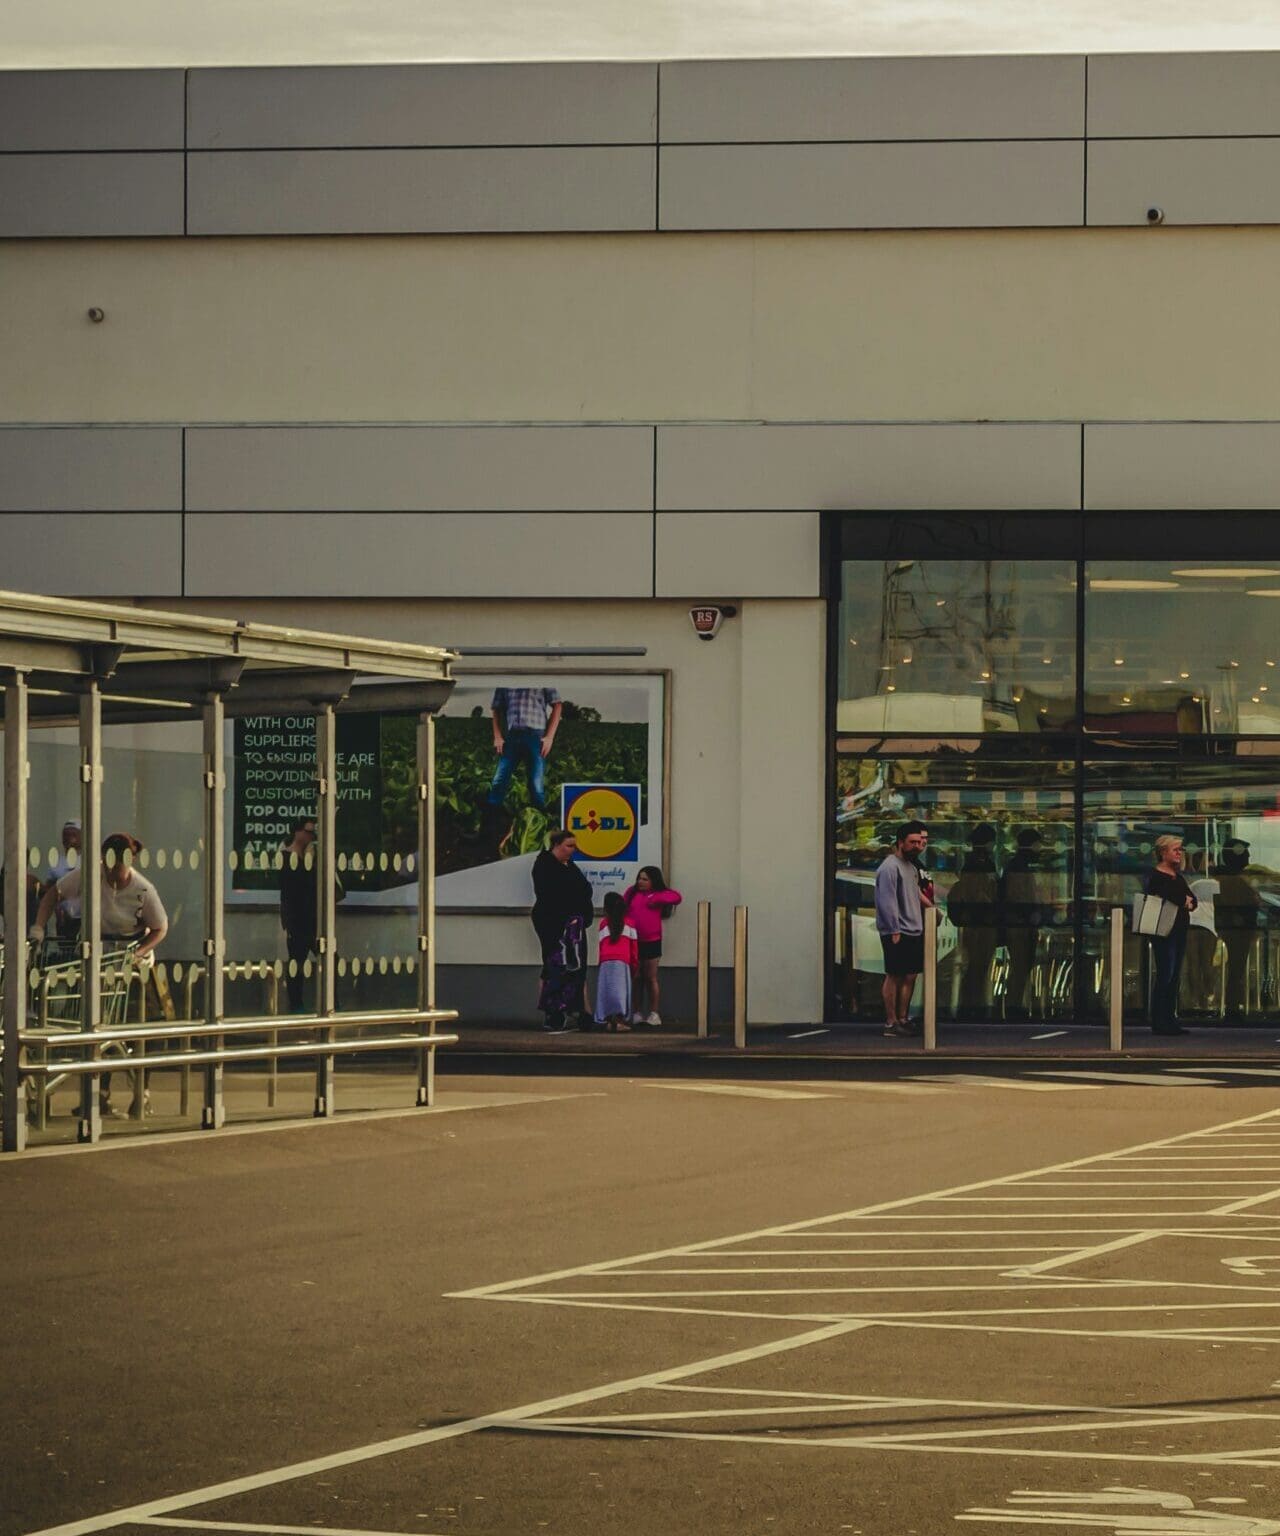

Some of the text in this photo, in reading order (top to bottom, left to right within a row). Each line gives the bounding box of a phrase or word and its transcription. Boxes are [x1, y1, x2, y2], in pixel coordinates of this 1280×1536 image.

[244, 717, 316, 729] WITH OUR
[244, 752, 264, 764] TO
[348, 753, 376, 765] ARE
[244, 805, 274, 817] TOP
[244, 841, 262, 852] AT
